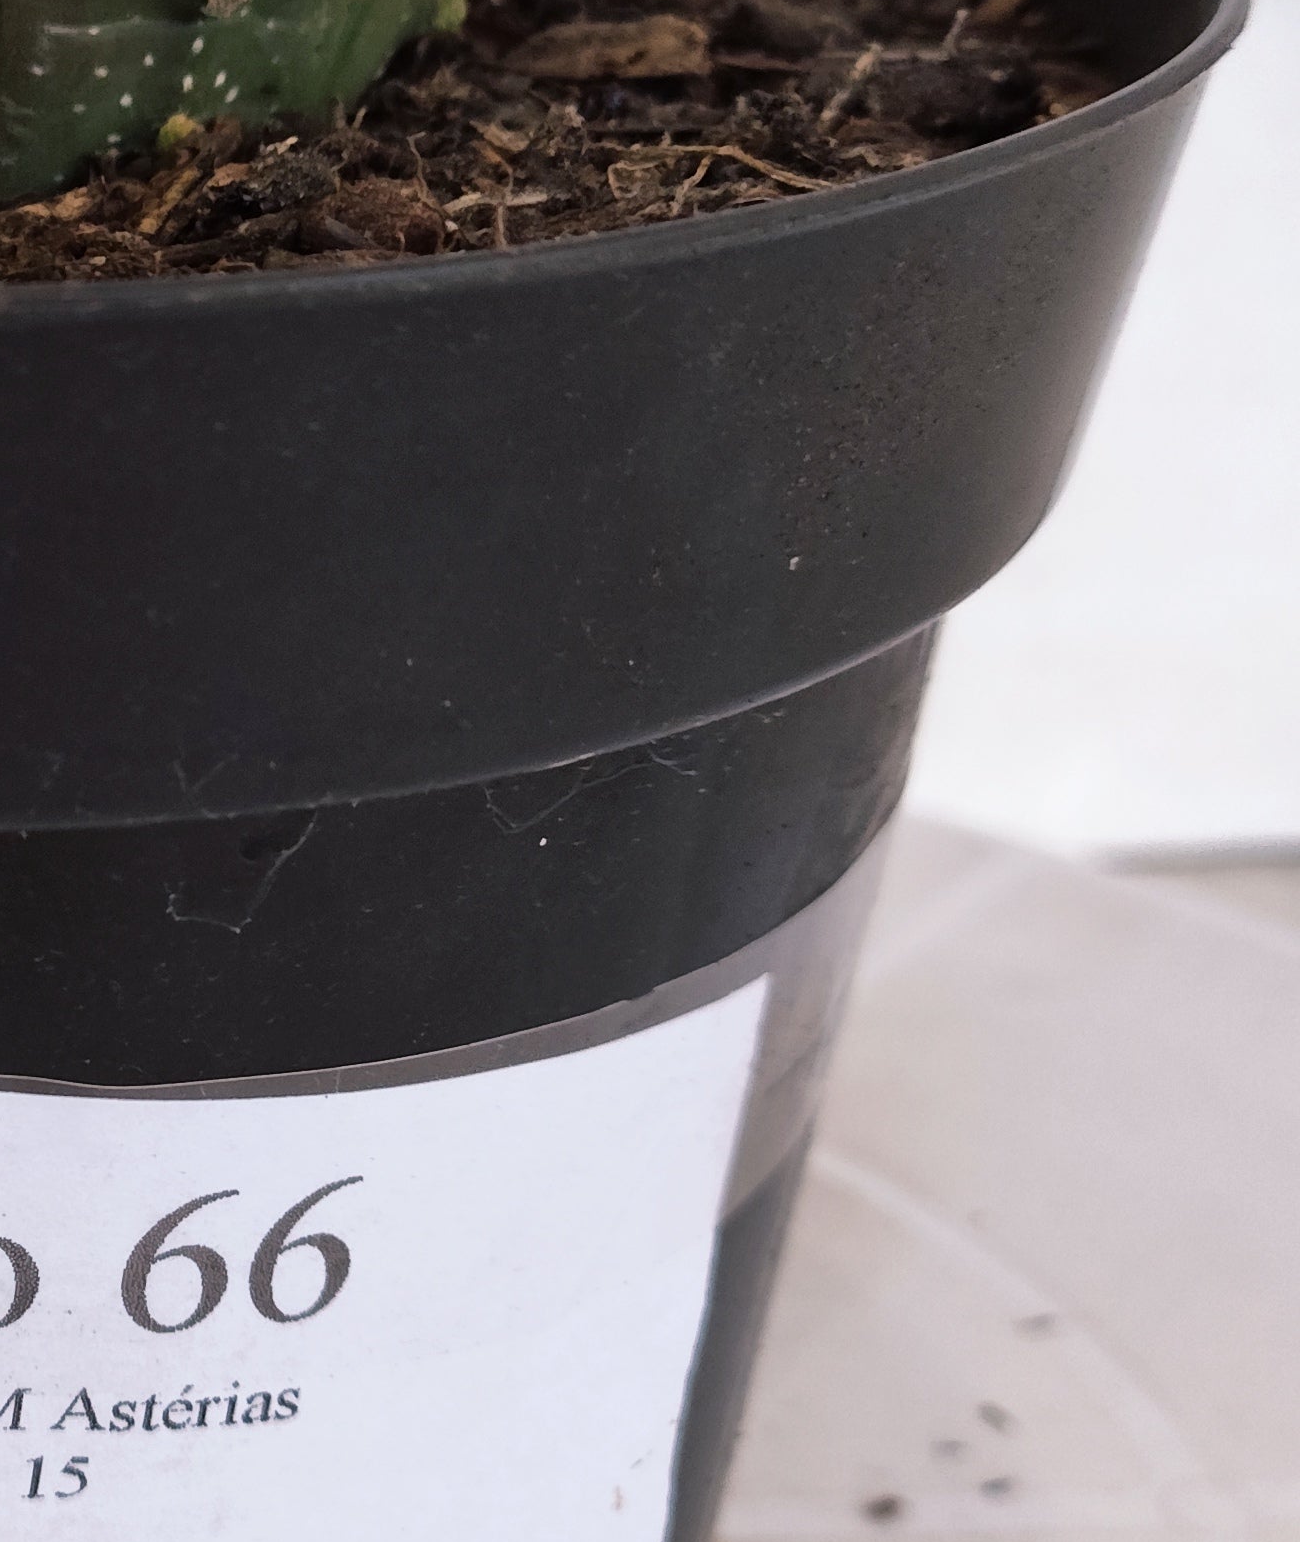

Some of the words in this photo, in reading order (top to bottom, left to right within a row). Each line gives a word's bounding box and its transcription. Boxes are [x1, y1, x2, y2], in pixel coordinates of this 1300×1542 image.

[119, 1174, 365, 1335] 66
[49, 1378, 301, 1435] Astérias
[21, 1454, 91, 1501] 15
